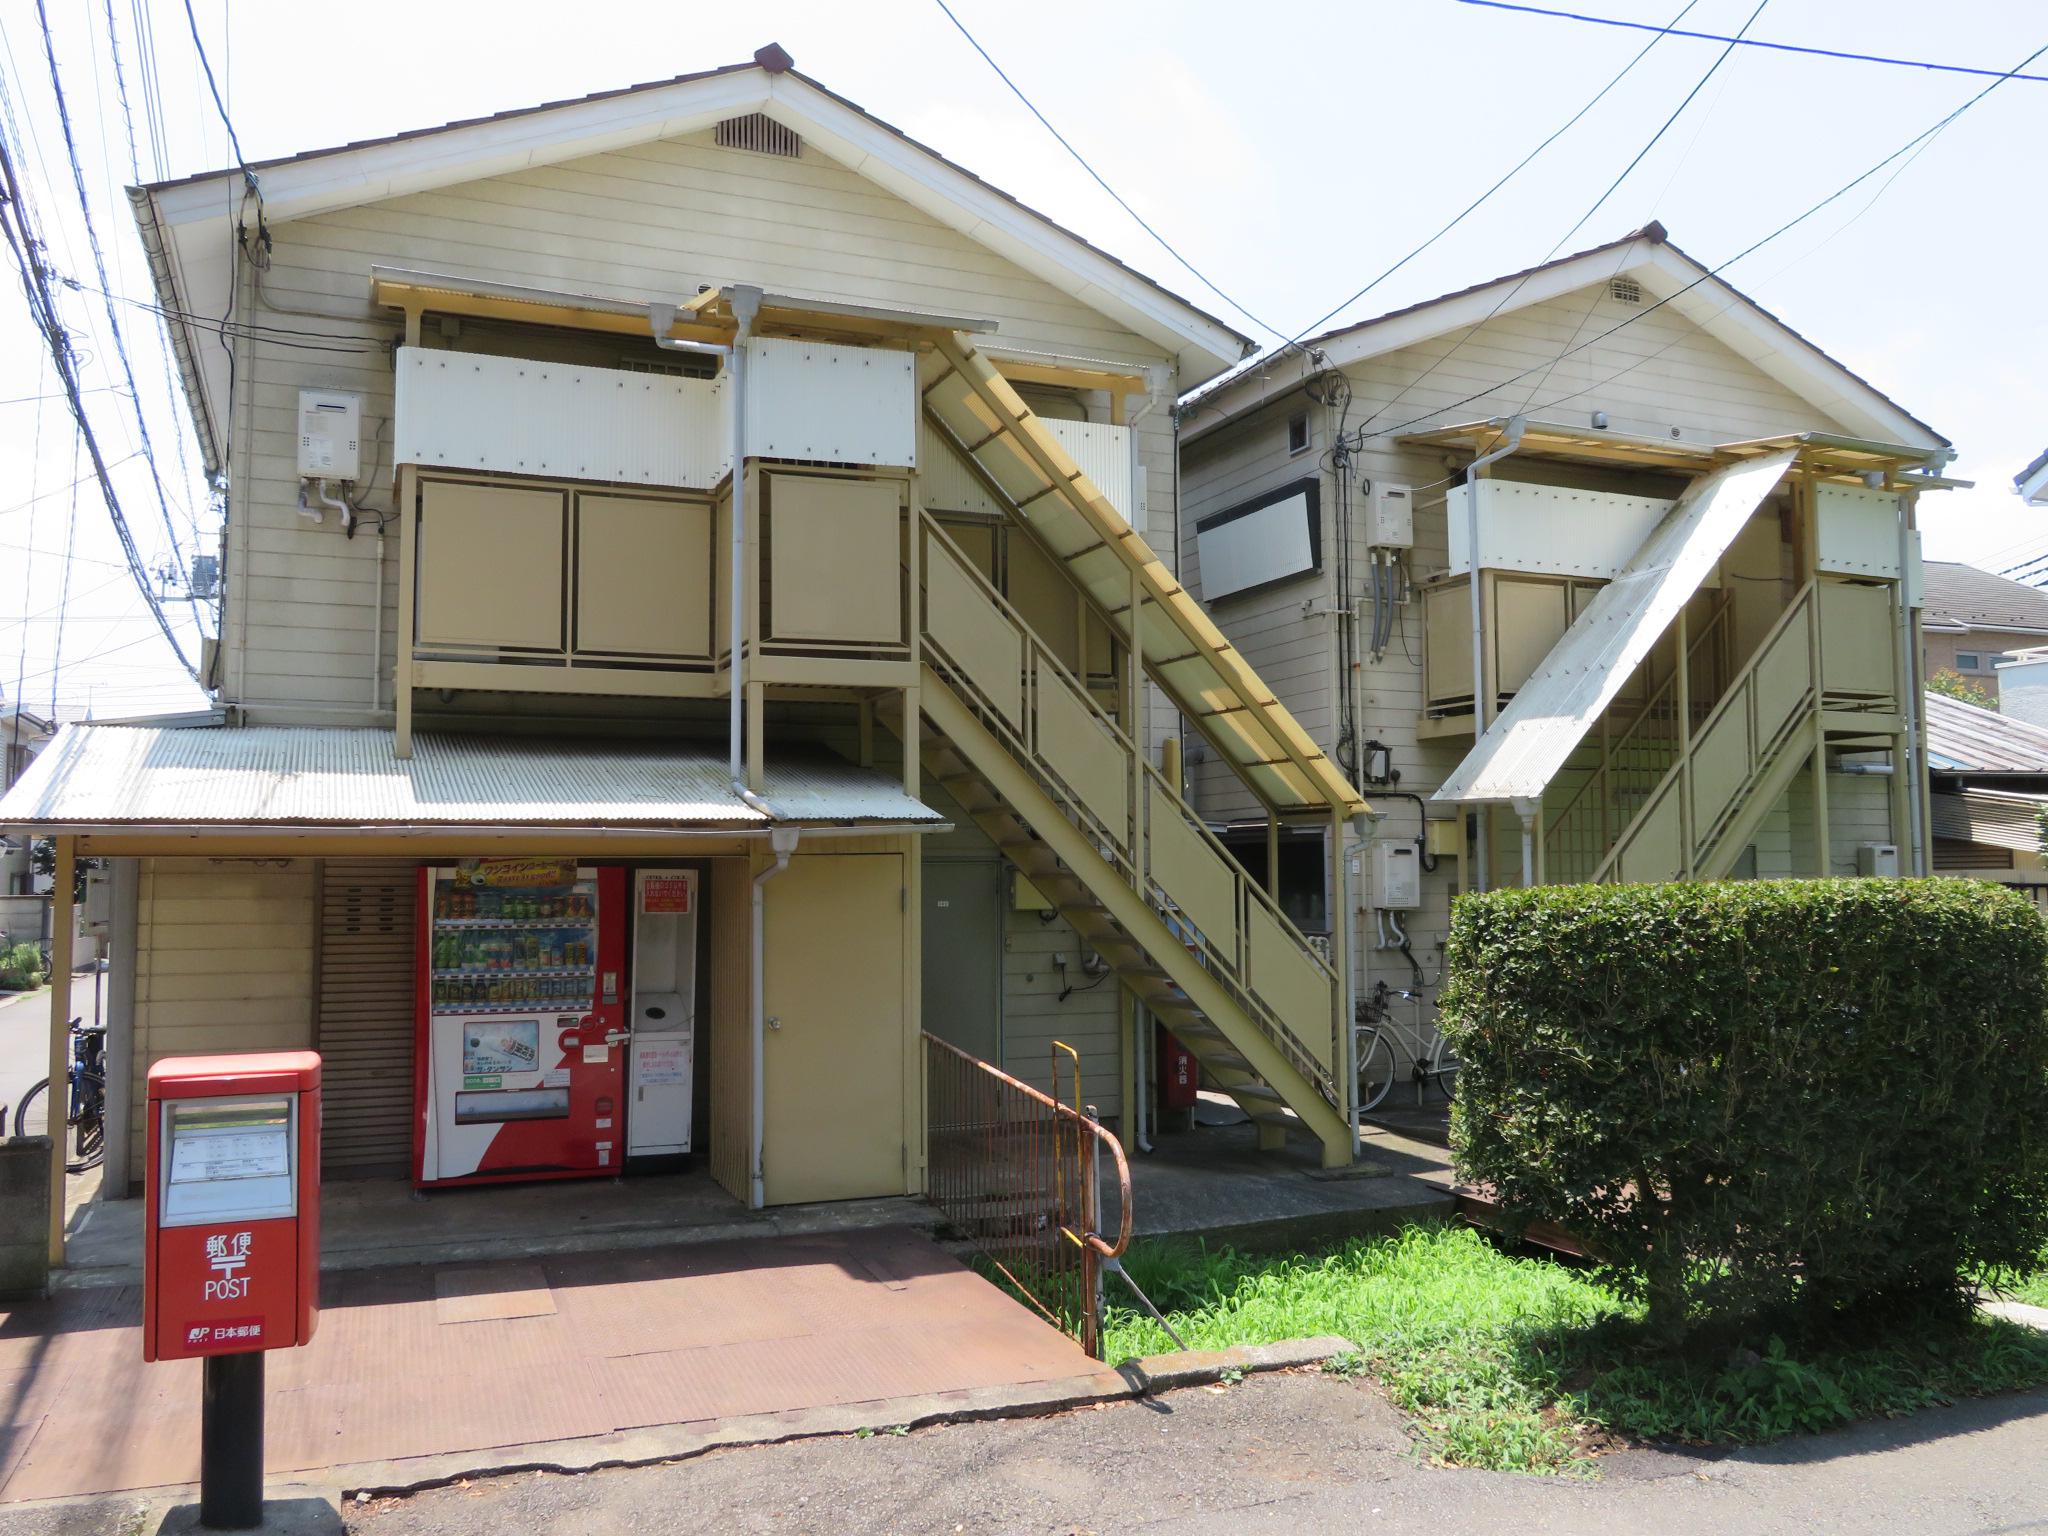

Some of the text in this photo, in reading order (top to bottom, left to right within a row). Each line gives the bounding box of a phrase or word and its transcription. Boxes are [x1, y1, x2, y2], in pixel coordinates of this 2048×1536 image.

[1178, 1055, 1188, 1085] 消火器
[207, 1231, 252, 1259] 郵便
[205, 1277, 252, 1301] POST
[215, 1324, 261, 1340] 日本郵便
